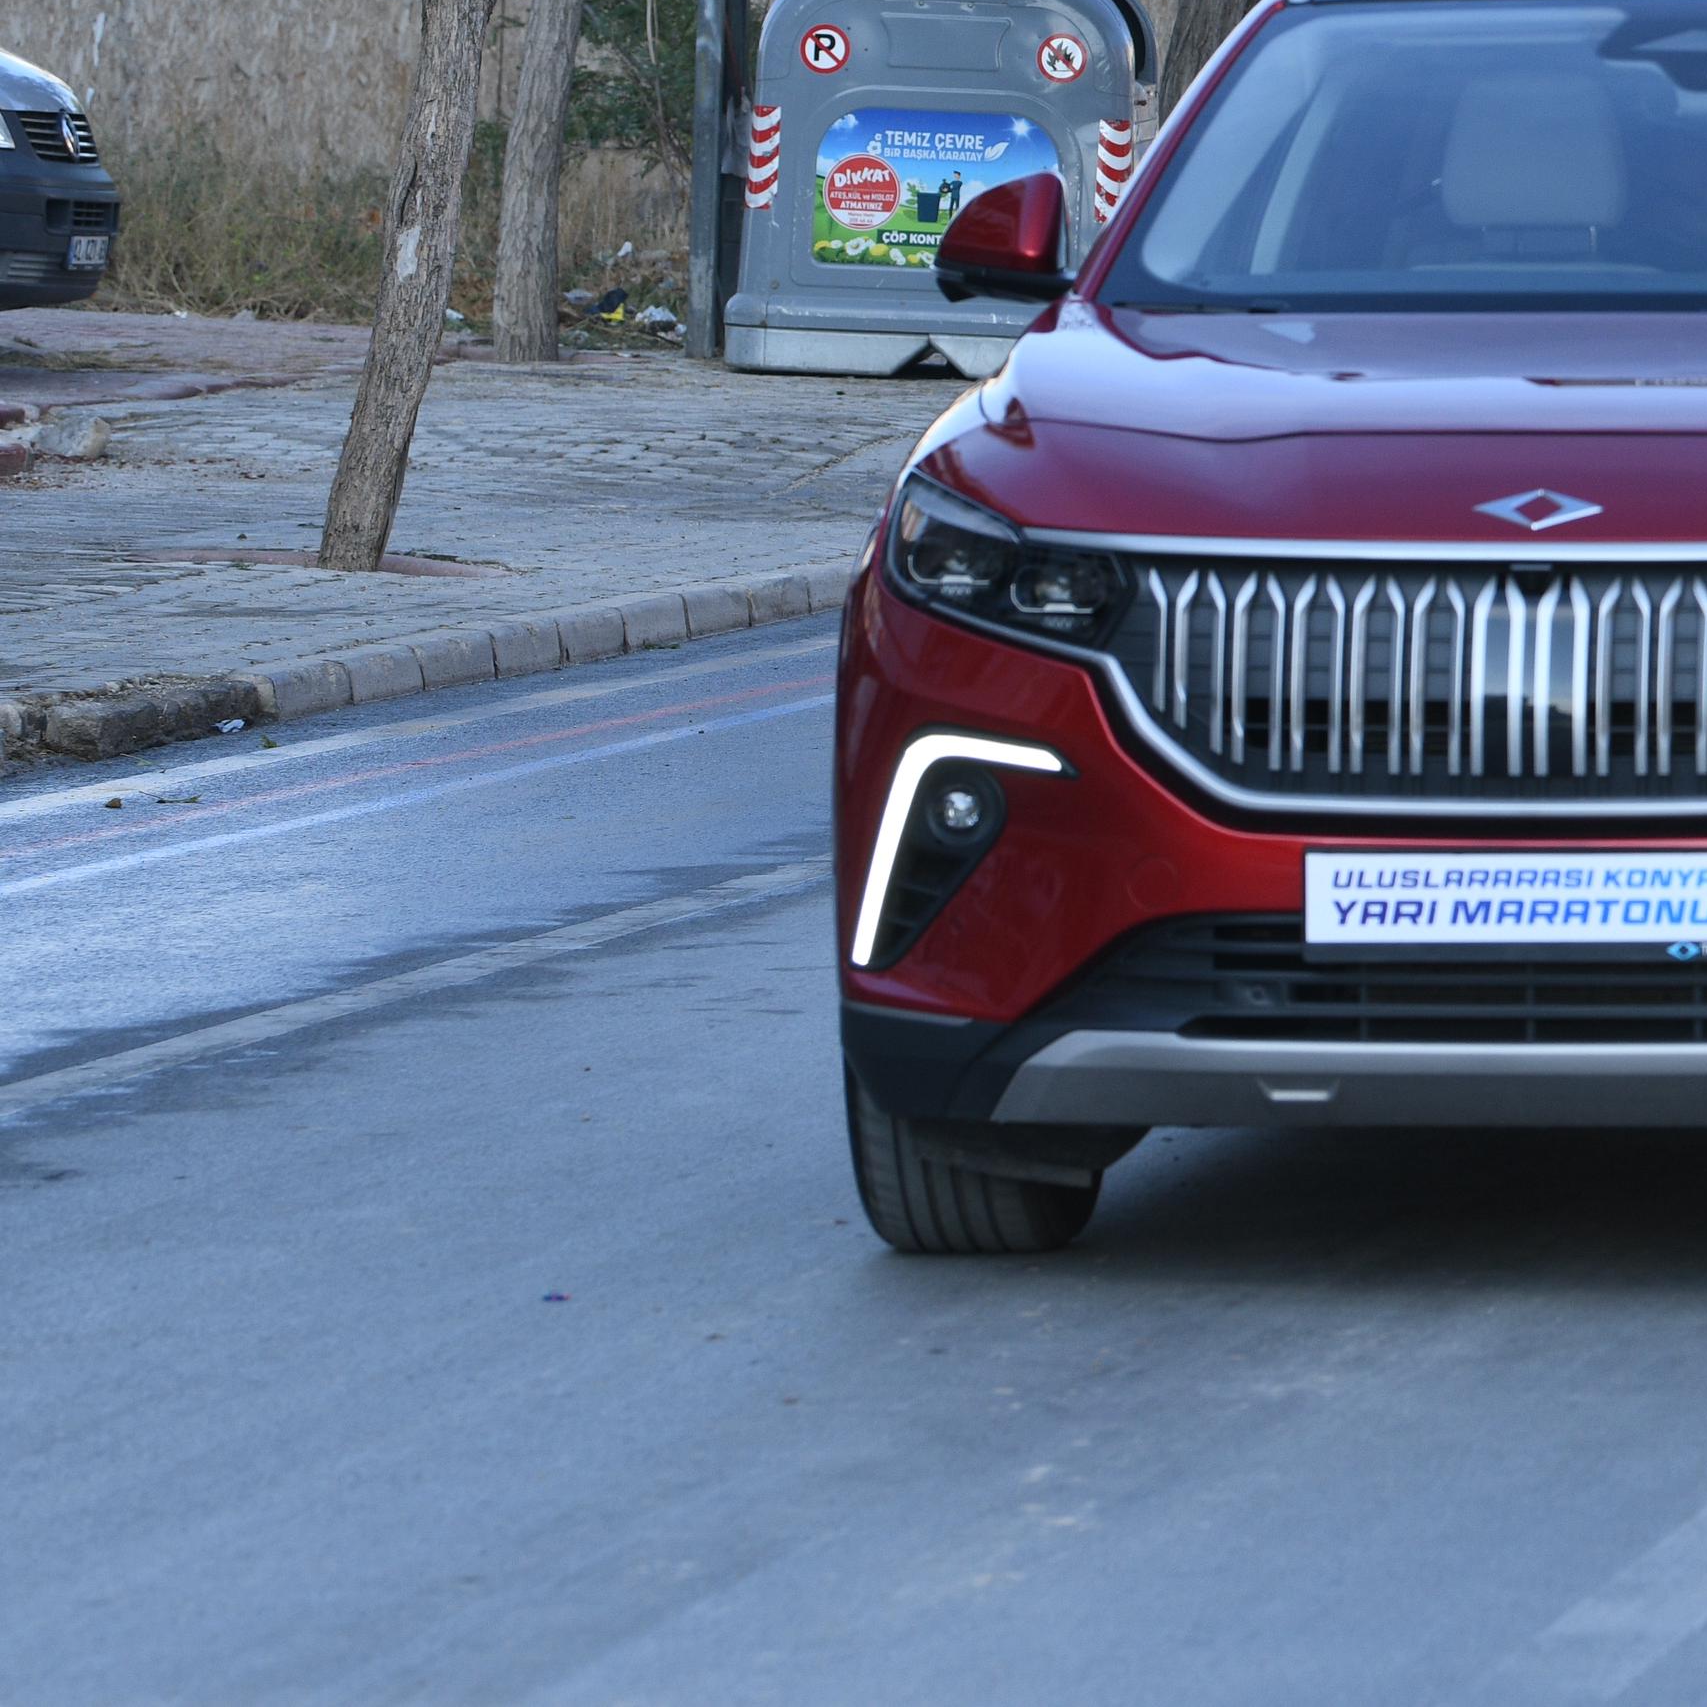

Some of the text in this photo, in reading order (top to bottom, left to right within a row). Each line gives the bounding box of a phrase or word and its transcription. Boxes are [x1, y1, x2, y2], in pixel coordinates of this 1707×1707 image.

[934, 132, 985, 151] ÇEVRE
[902, 149, 936, 160] BAŞKA
[938, 150, 983, 162] KARATAY
[840, 200, 884, 211] ATMAYINIZ
[881, 230, 907, 244] ÇÖP
[1333, 869, 1593, 889] ULUSLARARASI
[1334, 900, 1437, 925] YARI
